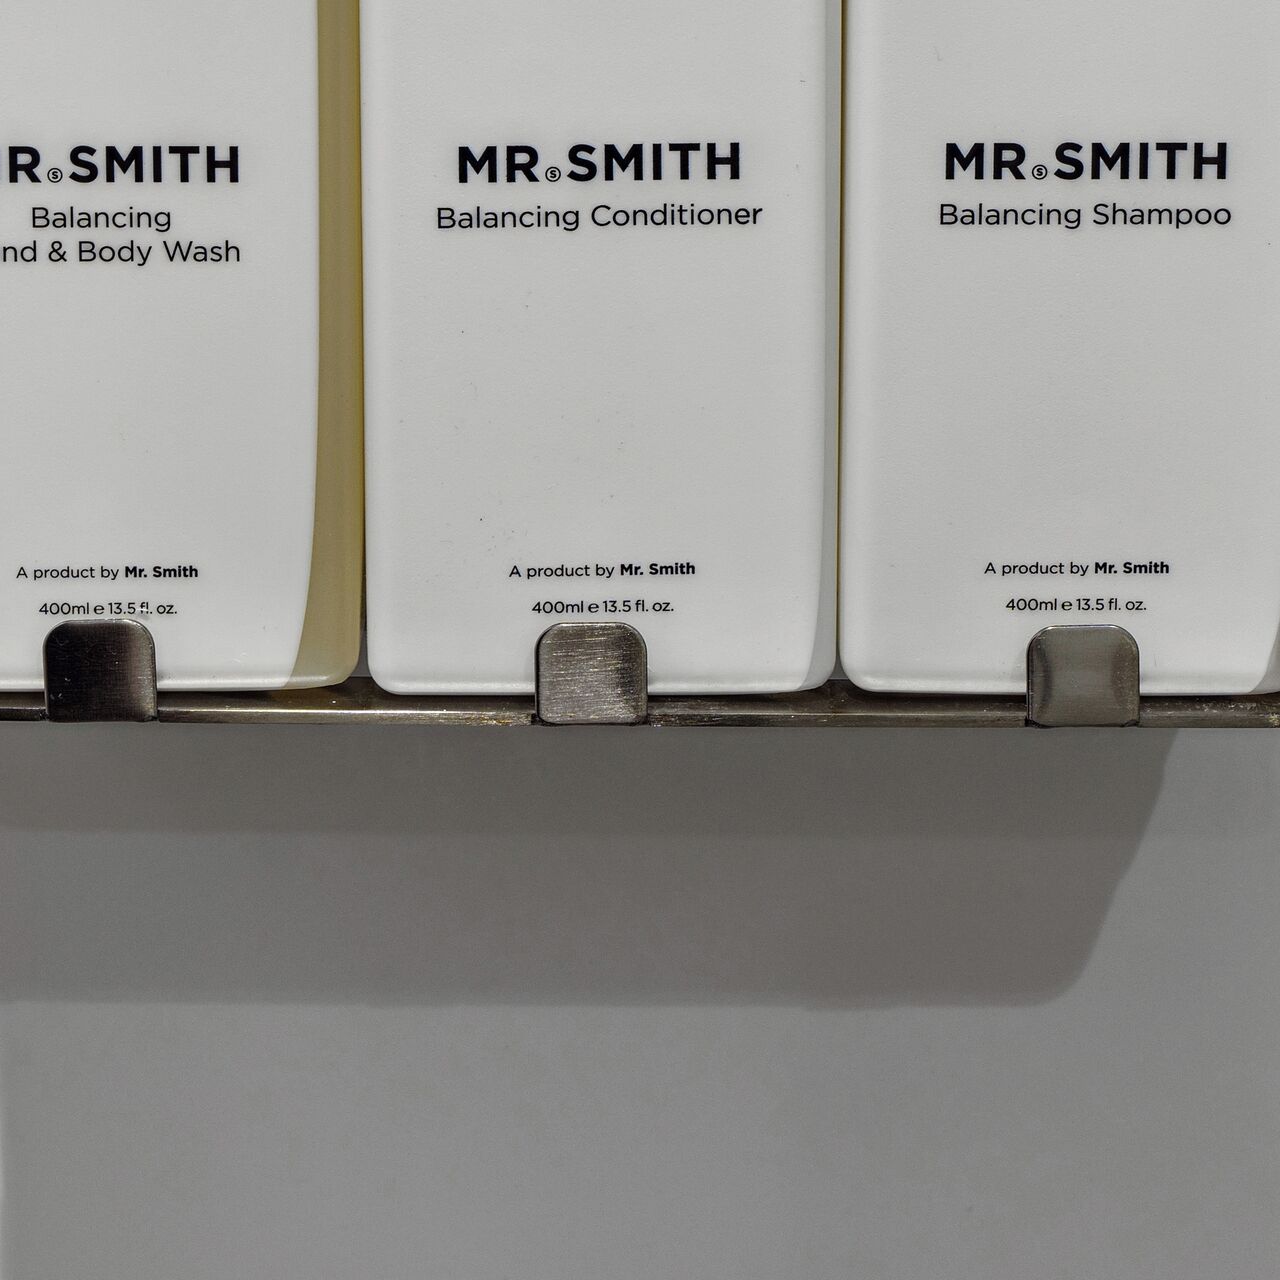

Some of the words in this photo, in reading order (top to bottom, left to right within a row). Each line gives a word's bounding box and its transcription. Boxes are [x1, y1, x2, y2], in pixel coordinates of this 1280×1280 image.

[68, 144, 240, 184] SMITH
[458, 144, 540, 184] MR
[566, 141, 741, 183] SMITH
[945, 142, 1027, 181] MR
[1053, 141, 1228, 181] SMITH
[31, 205, 171, 233] Balancing
[436, 205, 580, 232] Balancing
[590, 202, 764, 227] Conditioner
[939, 202, 1082, 230] Balancing
[1092, 202, 1232, 230] Shampoo
[47, 240, 68, 263] &
[78, 239, 153, 267] Body
[162, 239, 241, 263] Wash
[15, 566, 29, 579] A
[33, 565, 96, 581] product
[100, 565, 120, 581] by
[124, 565, 148, 579] Mr.
[152, 564, 199, 579] Smith
[508, 564, 522, 578] A
[526, 563, 591, 580] product
[595, 563, 616, 579] by
[620, 563, 644, 576] Mr.
[648, 561, 696, 576] Smith
[983, 561, 997, 575] A
[1001, 561, 1065, 577] product
[1069, 561, 1090, 577] by
[1094, 561, 1118, 575] Mr.
[1122, 560, 1170, 575] Smith
[38, 601, 90, 616] 400ml
[107, 602, 137, 615] 13.5
[156, 604, 178, 615] oz.
[531, 600, 584, 614] 400ml
[602, 599, 632, 614] 13.5
[634, 599, 649, 613] fl.
[651, 601, 675, 613] oz.
[1005, 597, 1058, 612] 400ml
[1075, 598, 1105, 611] 13.5
[1107, 597, 1122, 611] fl.
[1125, 600, 1147, 611] oz.
